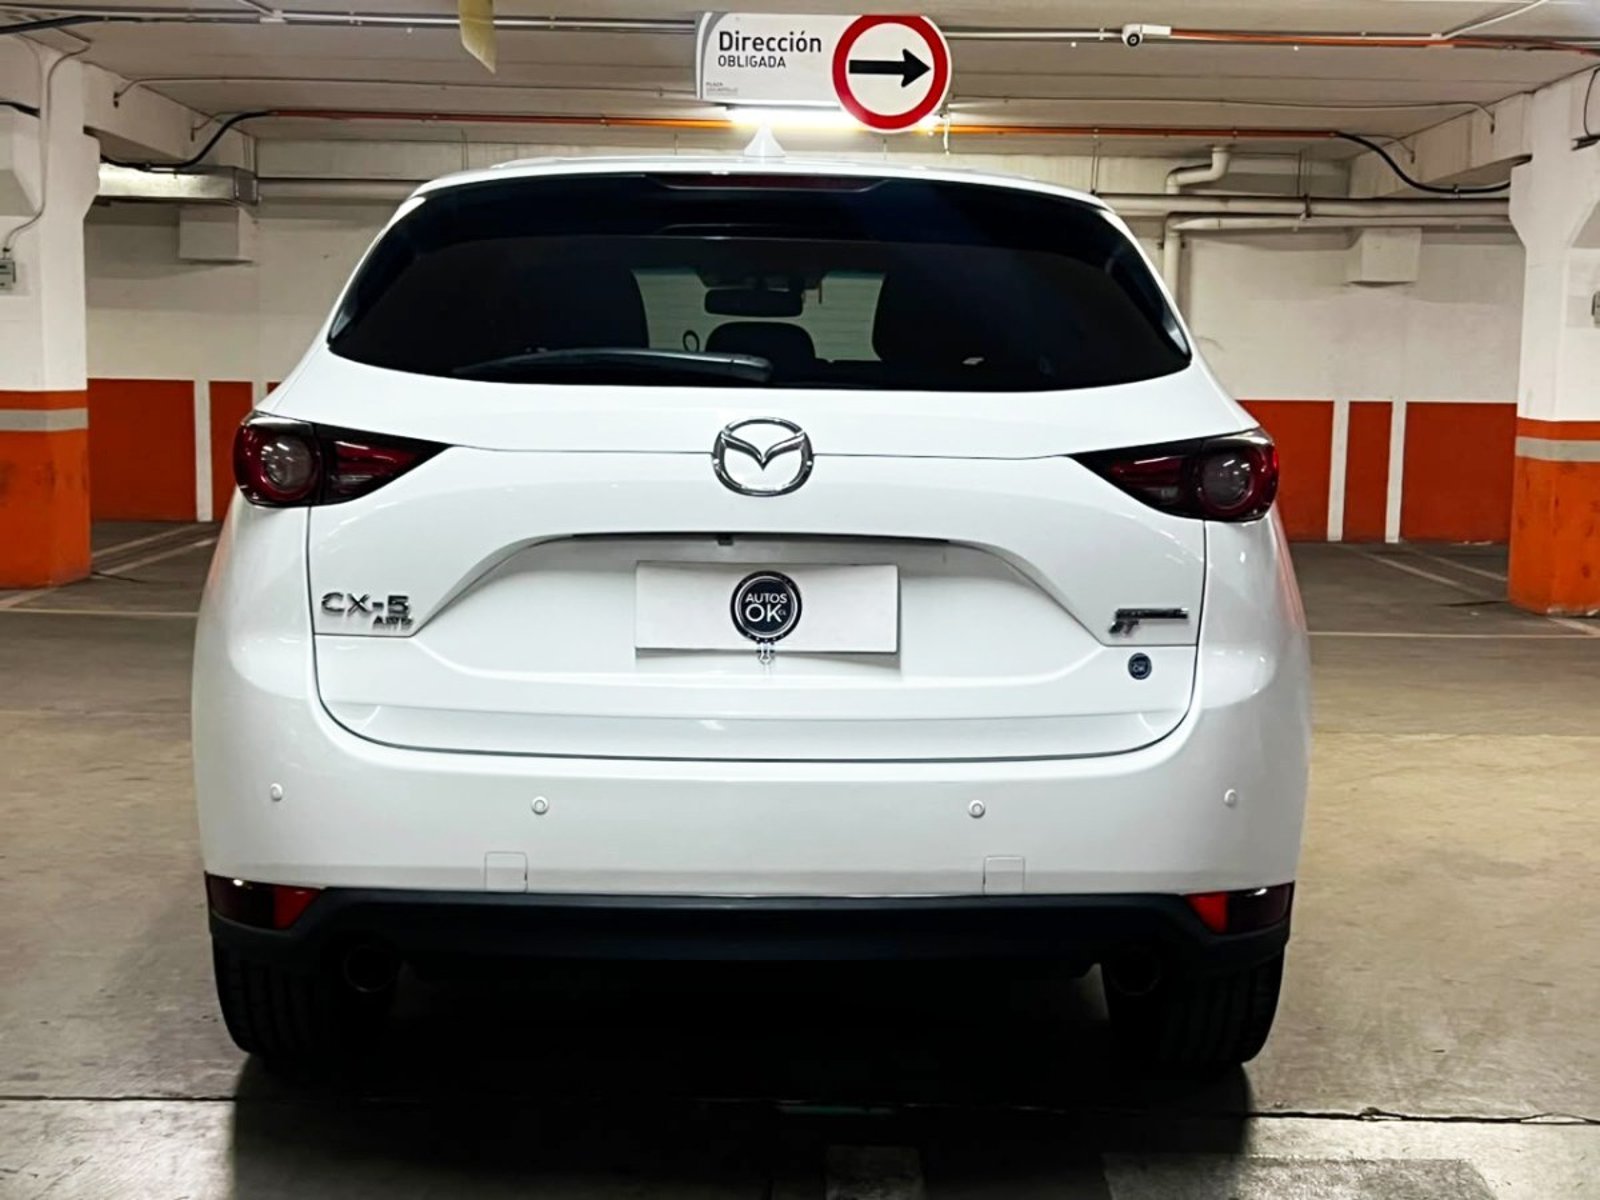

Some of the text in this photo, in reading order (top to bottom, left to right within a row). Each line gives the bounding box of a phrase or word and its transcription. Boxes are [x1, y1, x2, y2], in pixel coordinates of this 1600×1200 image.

[718, 30, 822, 53] Dirección
[718, 55, 786, 69] OBLIGADA
[321, 592, 409, 617] CX-5
[745, 593, 788, 604] AUTOS
[745, 603, 782, 622] OK
